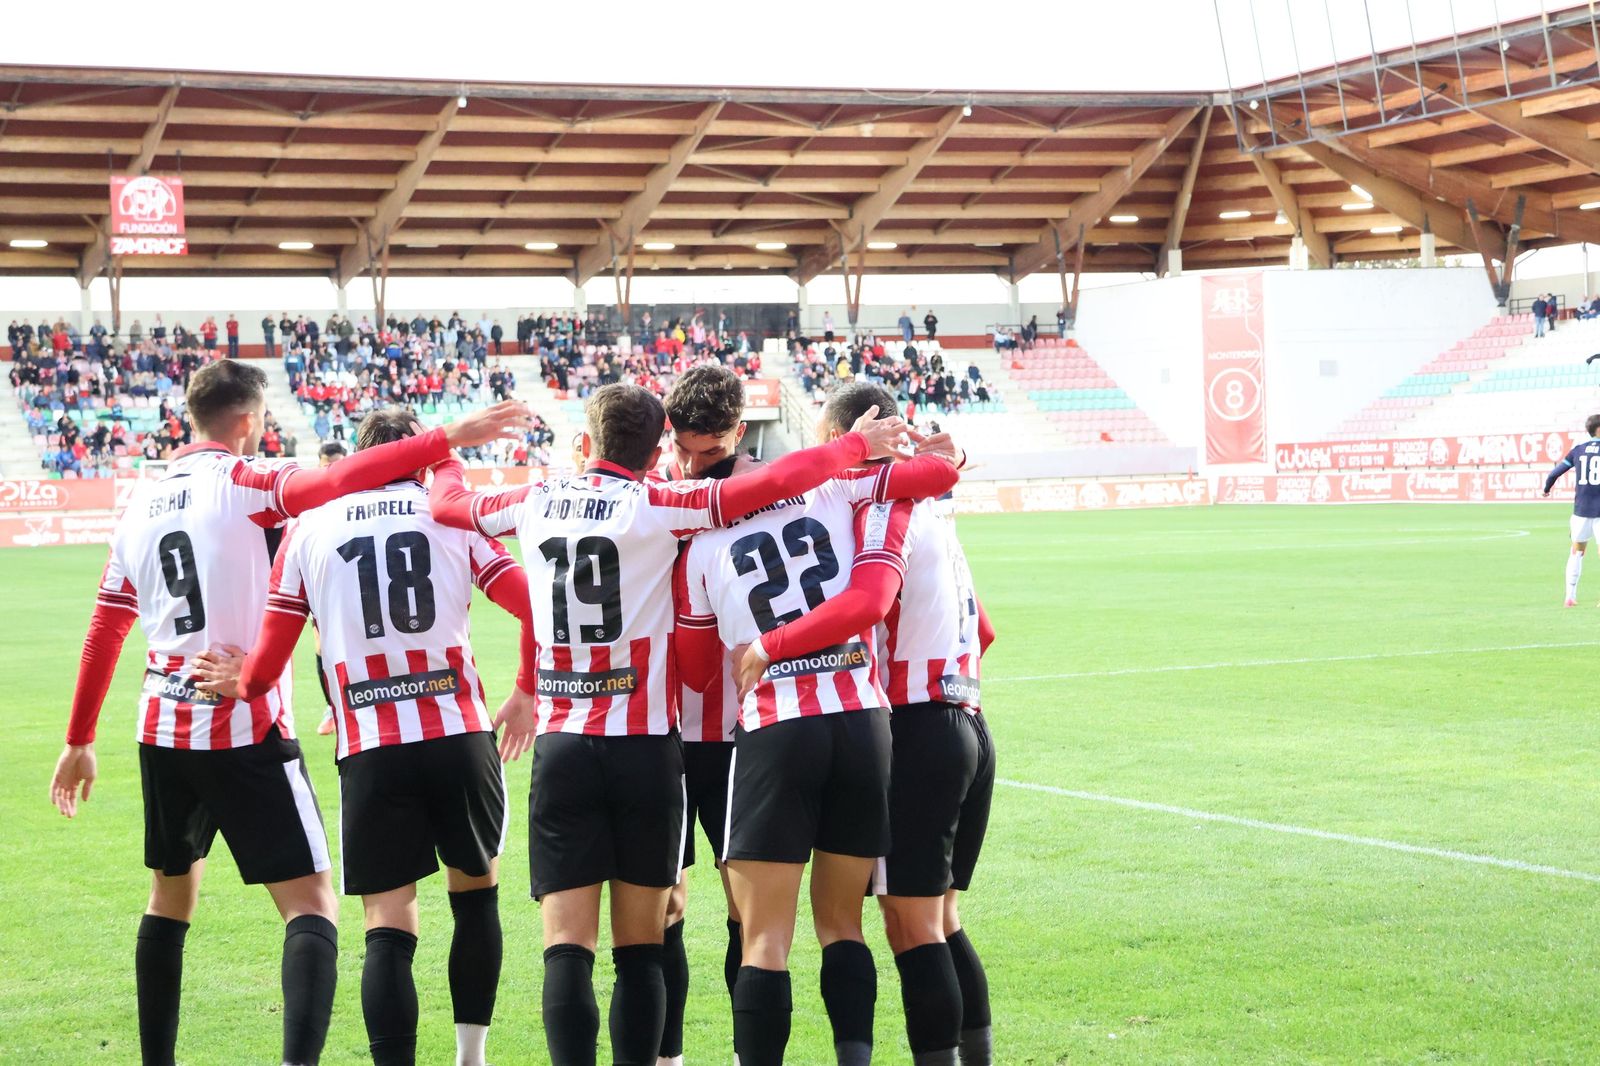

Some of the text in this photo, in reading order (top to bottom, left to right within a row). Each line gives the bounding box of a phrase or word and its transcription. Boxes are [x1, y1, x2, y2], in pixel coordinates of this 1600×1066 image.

[1226, 380, 1243, 408] 8
[1457, 434, 1520, 463] ZAMORA
[1520, 433, 1544, 462] CF
[1578, 455, 1600, 486] 18
[346, 500, 416, 521] FARRELL
[159, 530, 206, 636] 9
[336, 531, 436, 639] 18
[538, 536, 623, 644] 19
[730, 517, 840, 636] 22
[765, 648, 869, 677] eomotor.net
[348, 675, 456, 705] leomotor.net
[537, 673, 635, 694] leomotor.net
